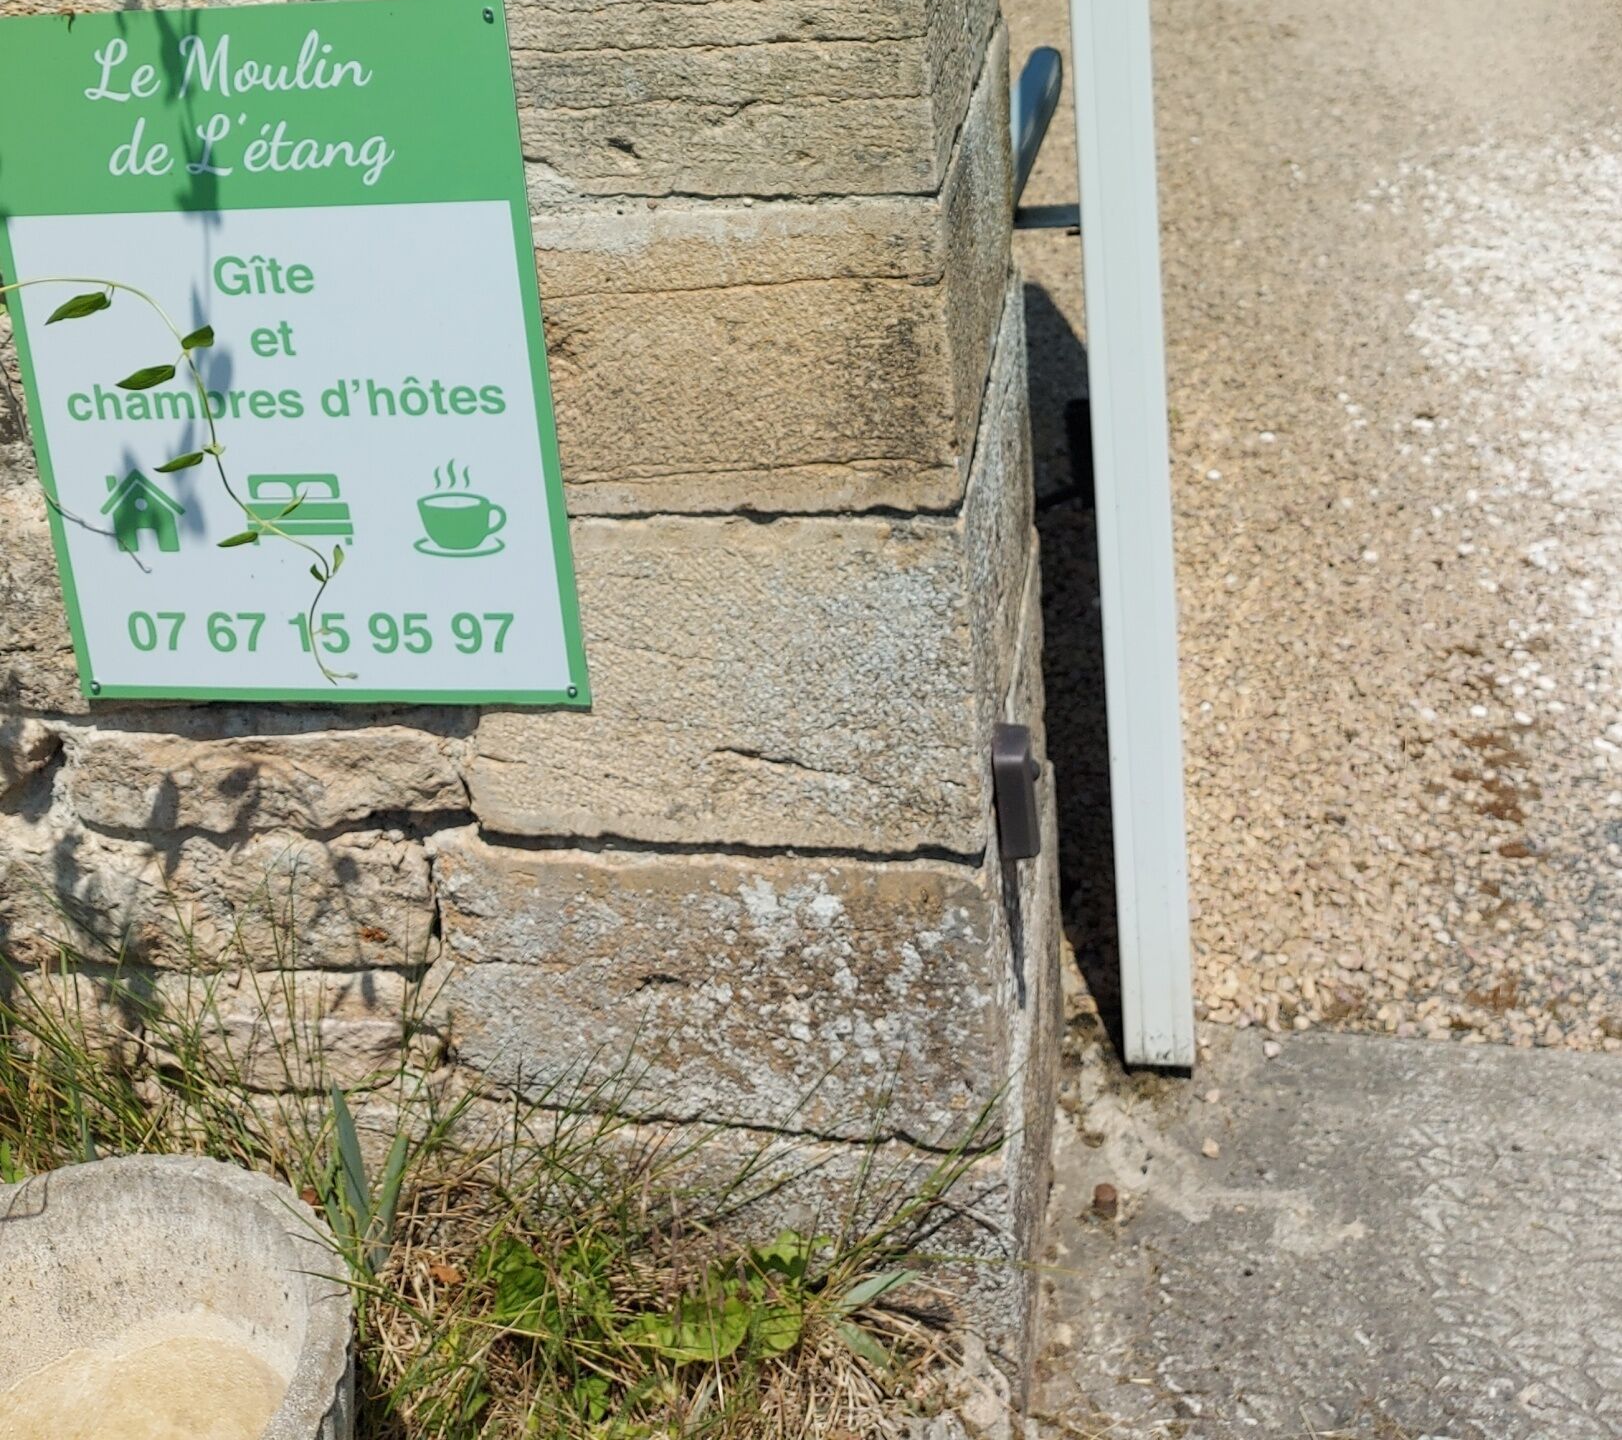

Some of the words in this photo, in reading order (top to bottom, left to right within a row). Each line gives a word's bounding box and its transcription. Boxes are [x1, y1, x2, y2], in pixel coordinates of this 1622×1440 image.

[85, 37, 160, 102] Le
[178, 28, 372, 99] Moulin
[108, 117, 174, 177] de
[184, 113, 394, 187] L'étang
[213, 255, 315, 296] Gîte
[250, 319, 297, 358] et
[67, 381, 304, 422] chambres
[320, 376, 507, 418] d'hôtes
[127, 611, 186, 653] 07
[206, 611, 267, 653] 67
[288, 611, 350, 654] 15
[367, 612, 433, 655] 95
[451, 612, 515, 655] 97
